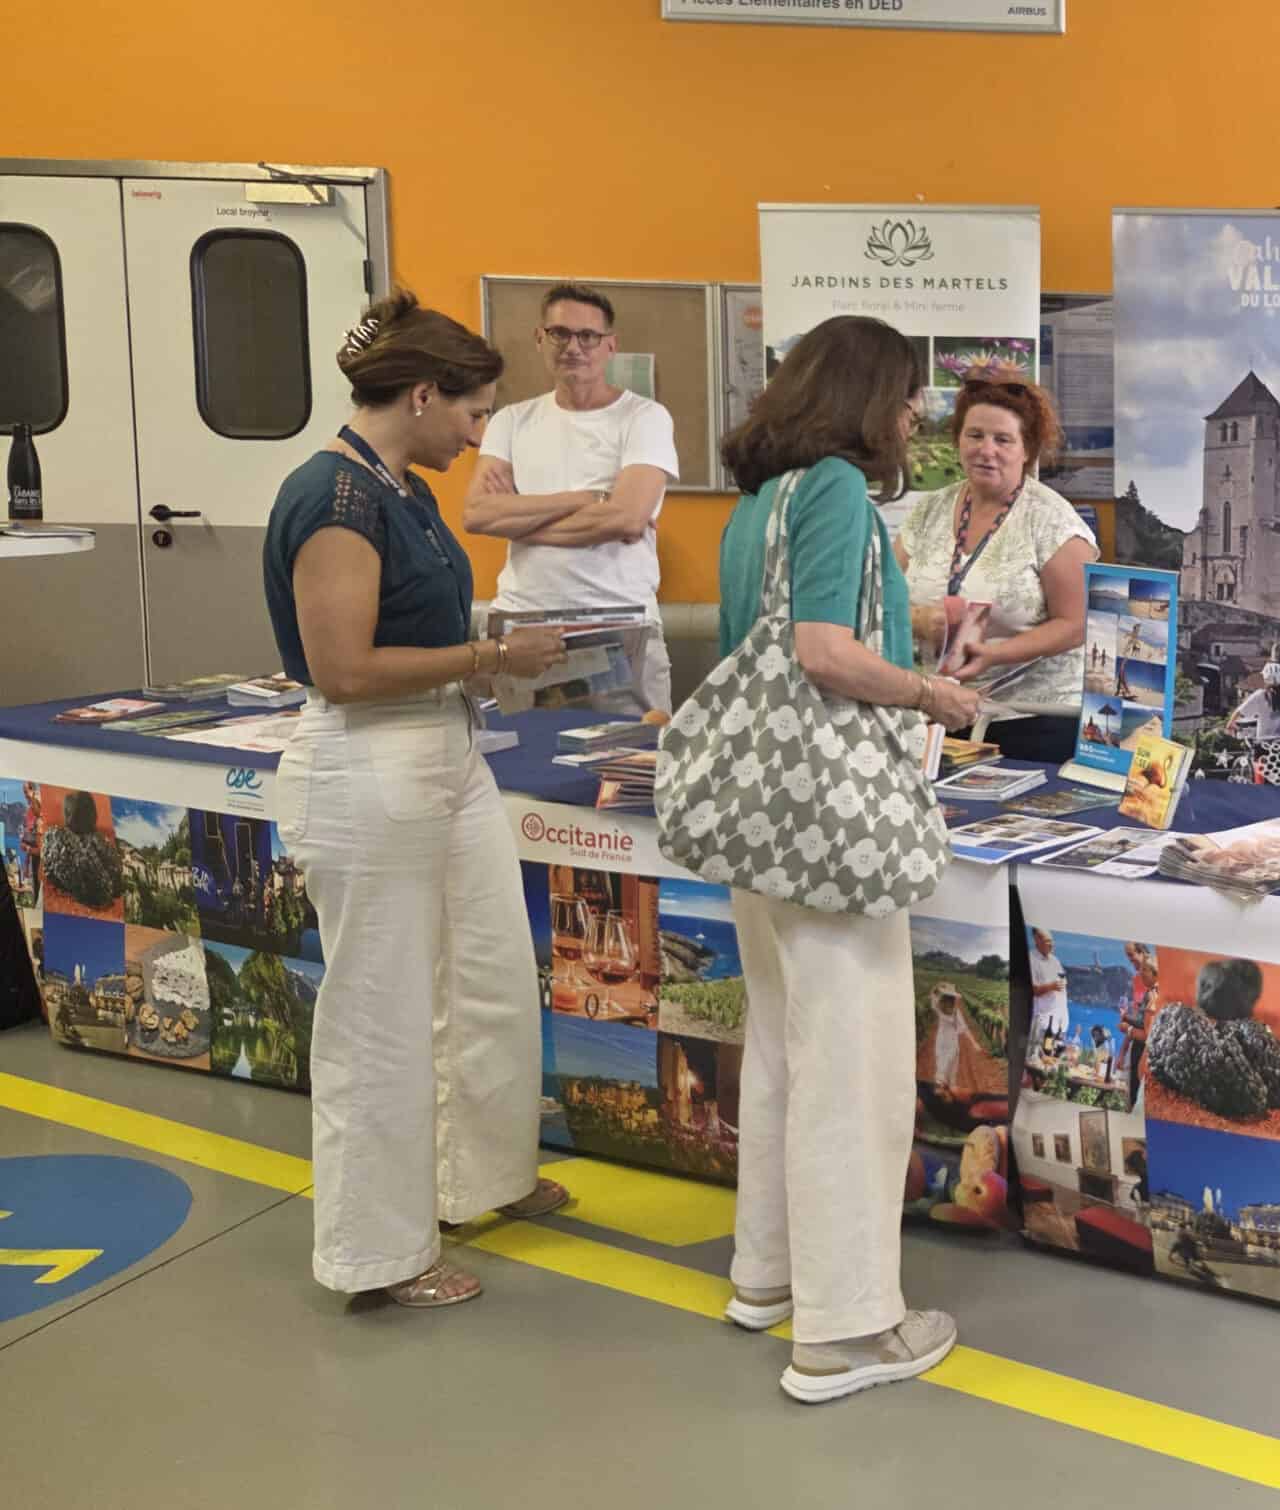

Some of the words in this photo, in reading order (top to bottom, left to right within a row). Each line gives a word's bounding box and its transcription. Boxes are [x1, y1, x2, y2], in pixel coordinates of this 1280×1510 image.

[845, 0, 864, 10] en
[869, 0, 904, 11] DED
[1007, 6, 1047, 17] AIRBUS
[791, 275, 872, 289] JARDINS
[879, 276, 915, 290] DES
[923, 277, 1009, 291] MARTELS
[1240, 293, 1260, 308] DU
[226, 767, 264, 789] cse
[521, 812, 634, 852] Occitanie
